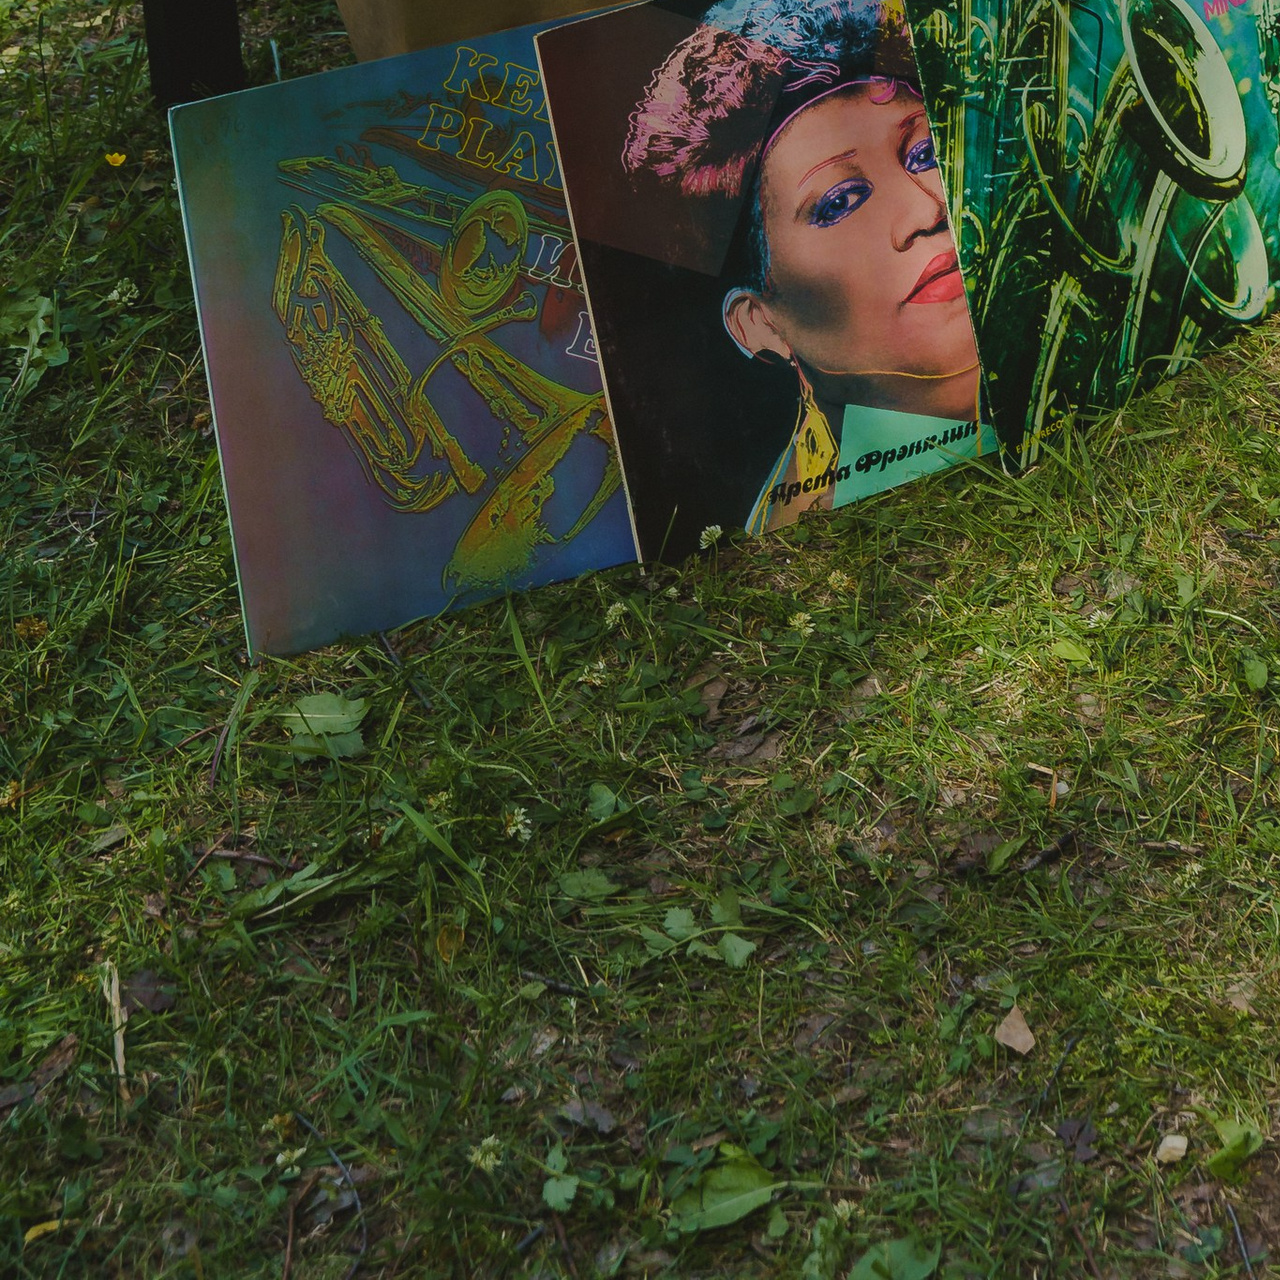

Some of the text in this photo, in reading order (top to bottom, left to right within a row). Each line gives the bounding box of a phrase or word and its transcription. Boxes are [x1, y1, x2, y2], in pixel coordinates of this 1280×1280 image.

[443, 46, 550, 123] KE
[766, 419, 980, 506] Арета Фрэнклин
